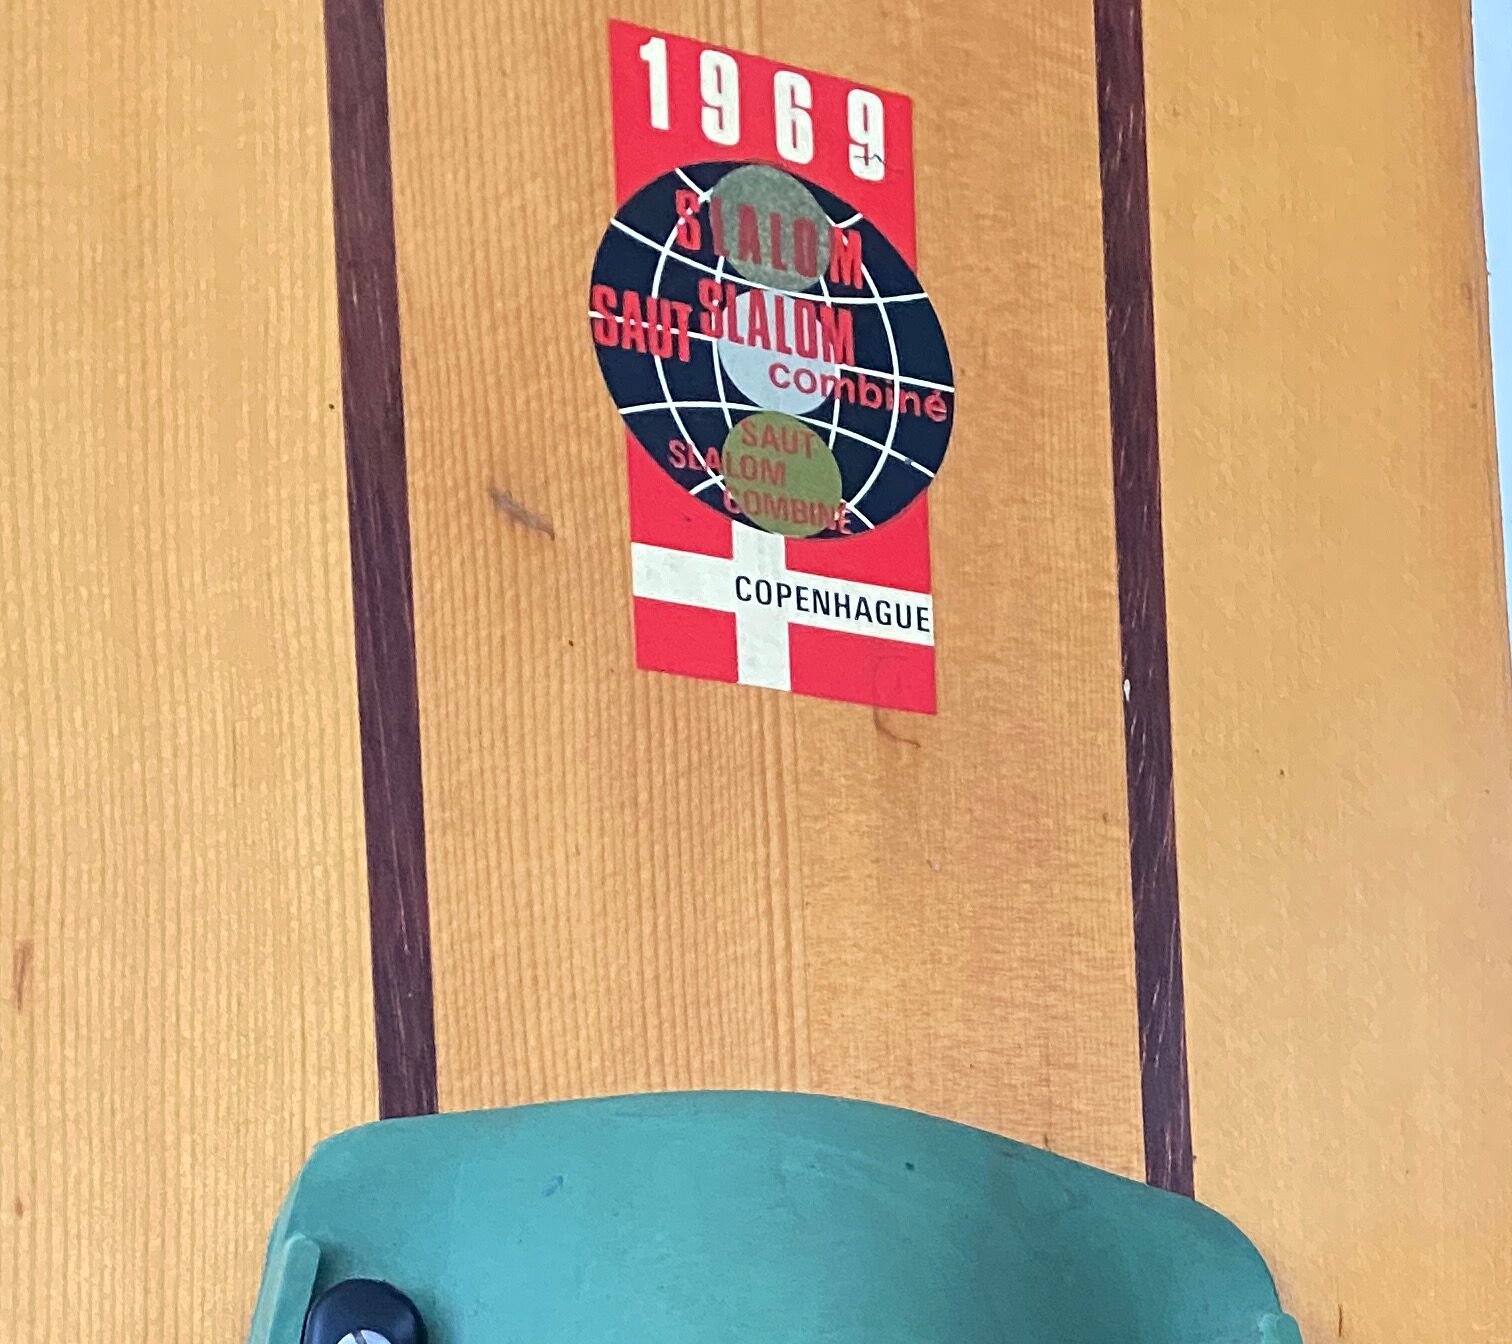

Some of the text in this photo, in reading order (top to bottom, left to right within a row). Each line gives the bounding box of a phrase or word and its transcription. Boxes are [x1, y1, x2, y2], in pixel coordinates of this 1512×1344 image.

[639, 36, 886, 182] 1969
[674, 188, 864, 290] SLALOM
[591, 284, 693, 363] SAUT
[699, 278, 856, 366] SLALOM
[668, 438, 788, 488] SLALOM
[740, 419, 817, 459] SAUT
[735, 575, 931, 633] COPENHAGUE
